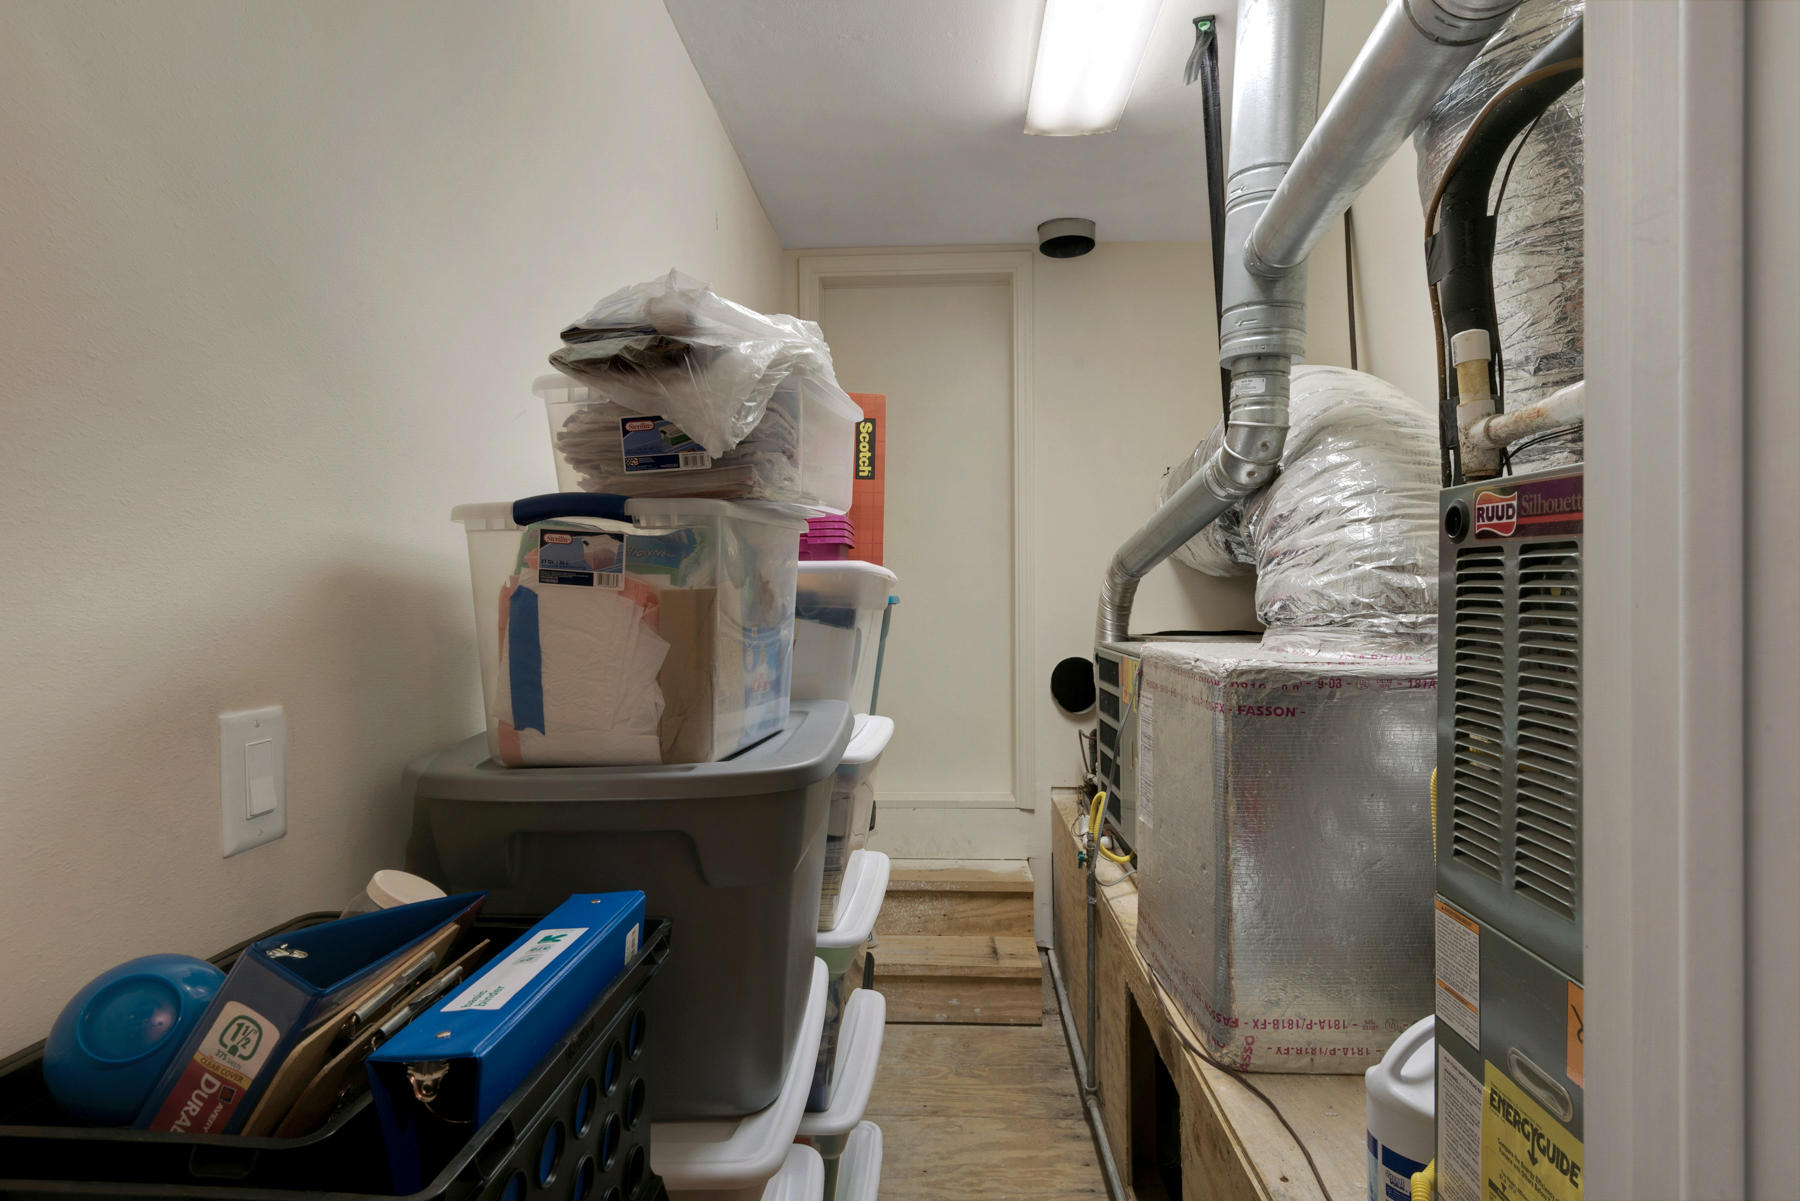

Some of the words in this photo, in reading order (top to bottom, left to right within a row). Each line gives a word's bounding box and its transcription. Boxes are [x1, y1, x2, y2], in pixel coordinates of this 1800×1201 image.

[859, 421, 873, 477] Scotch
[1476, 503, 1516, 523] RUUD
[1521, 493, 1583, 516] Silhouett
[1237, 705, 1296, 717] FASSON
[221, 1066, 245, 1083] COVER
[1489, 1086, 1581, 1189] ENERGYGUIDE
